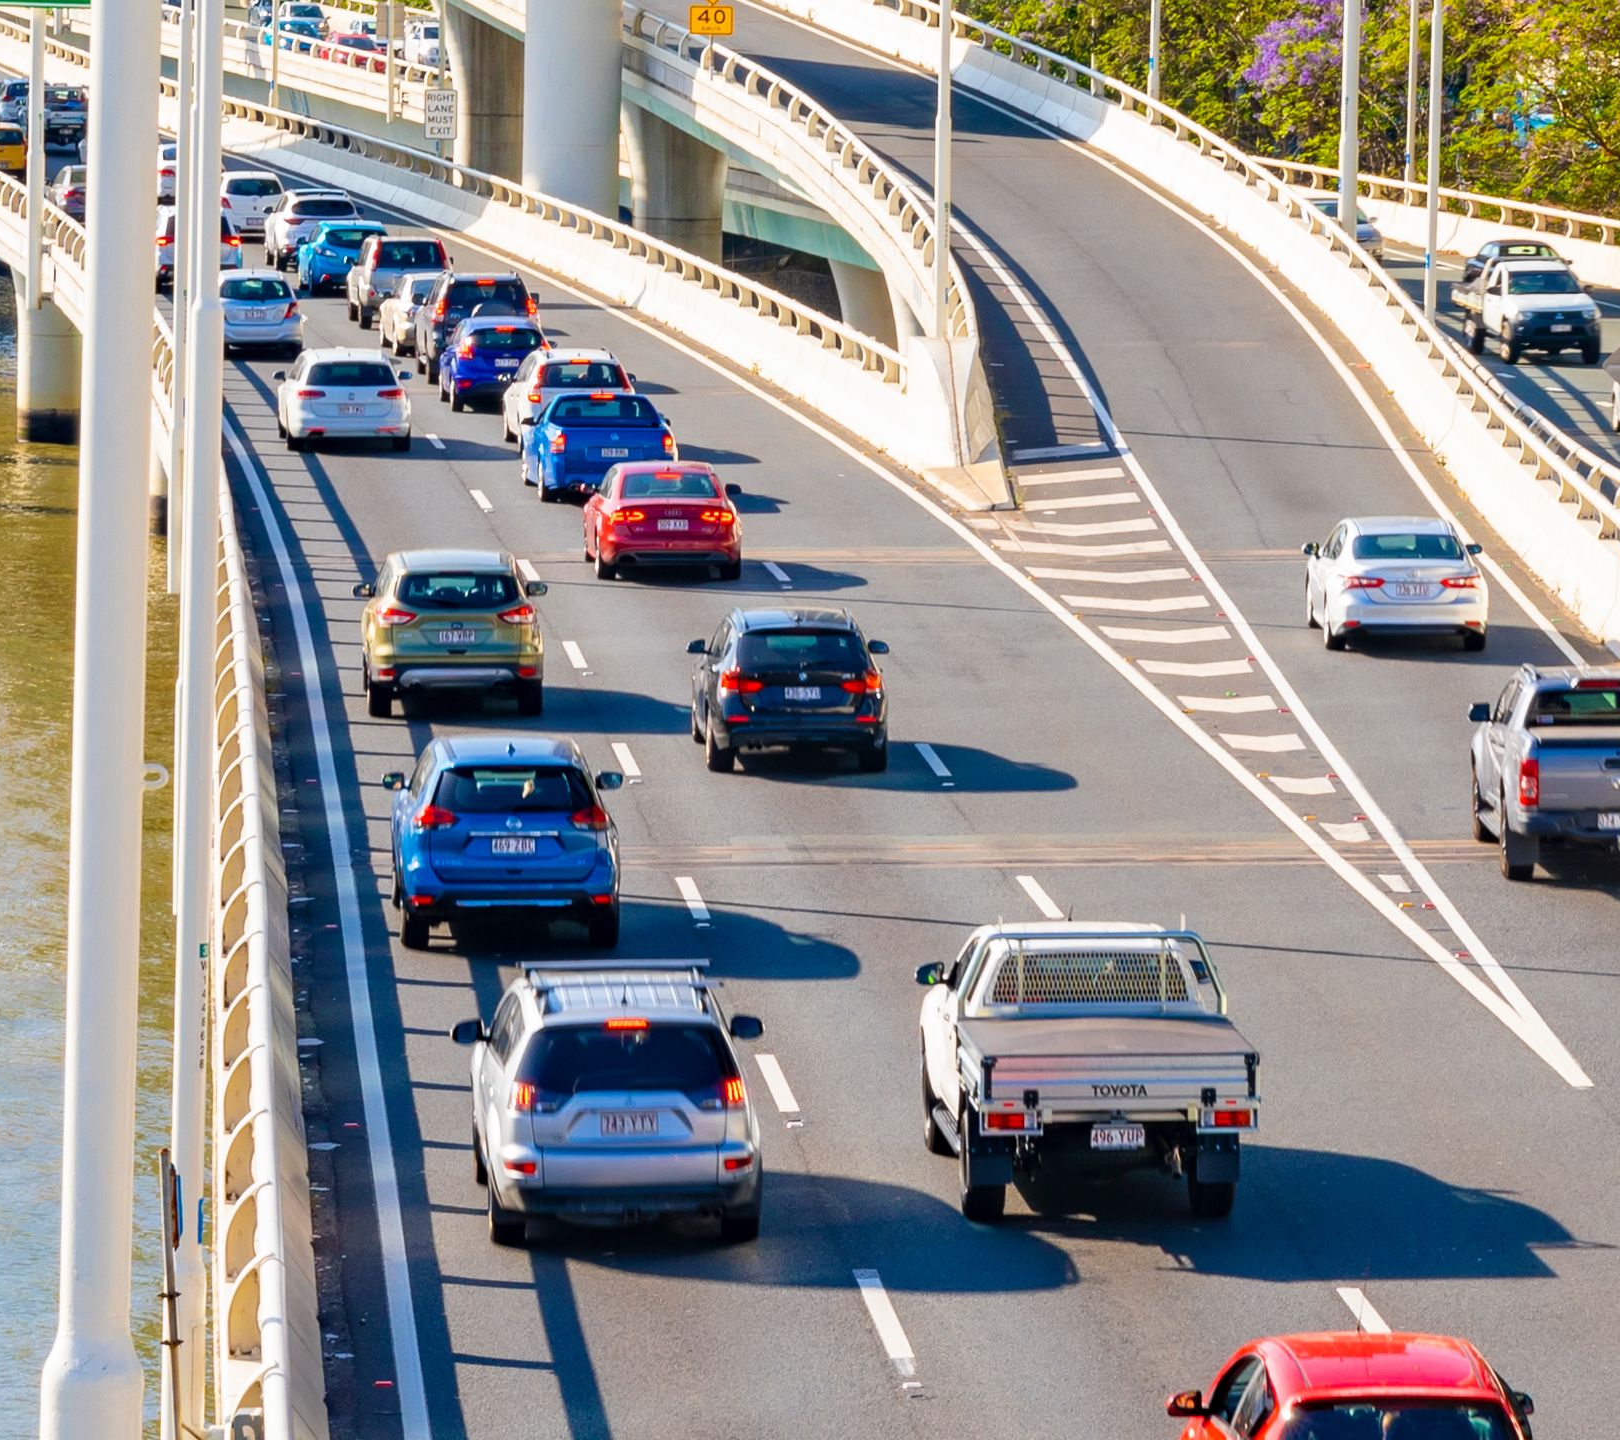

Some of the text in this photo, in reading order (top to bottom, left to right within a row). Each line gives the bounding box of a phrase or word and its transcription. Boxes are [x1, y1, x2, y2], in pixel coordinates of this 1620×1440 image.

[697, 9, 726, 25] 40
[427, 93, 455, 102] RIGHT
[427, 105, 454, 113] LANE
[427, 116, 454, 124] MUST
[430, 127, 452, 135] EXIT
[1091, 1084, 1149, 1098] TOYOTA
